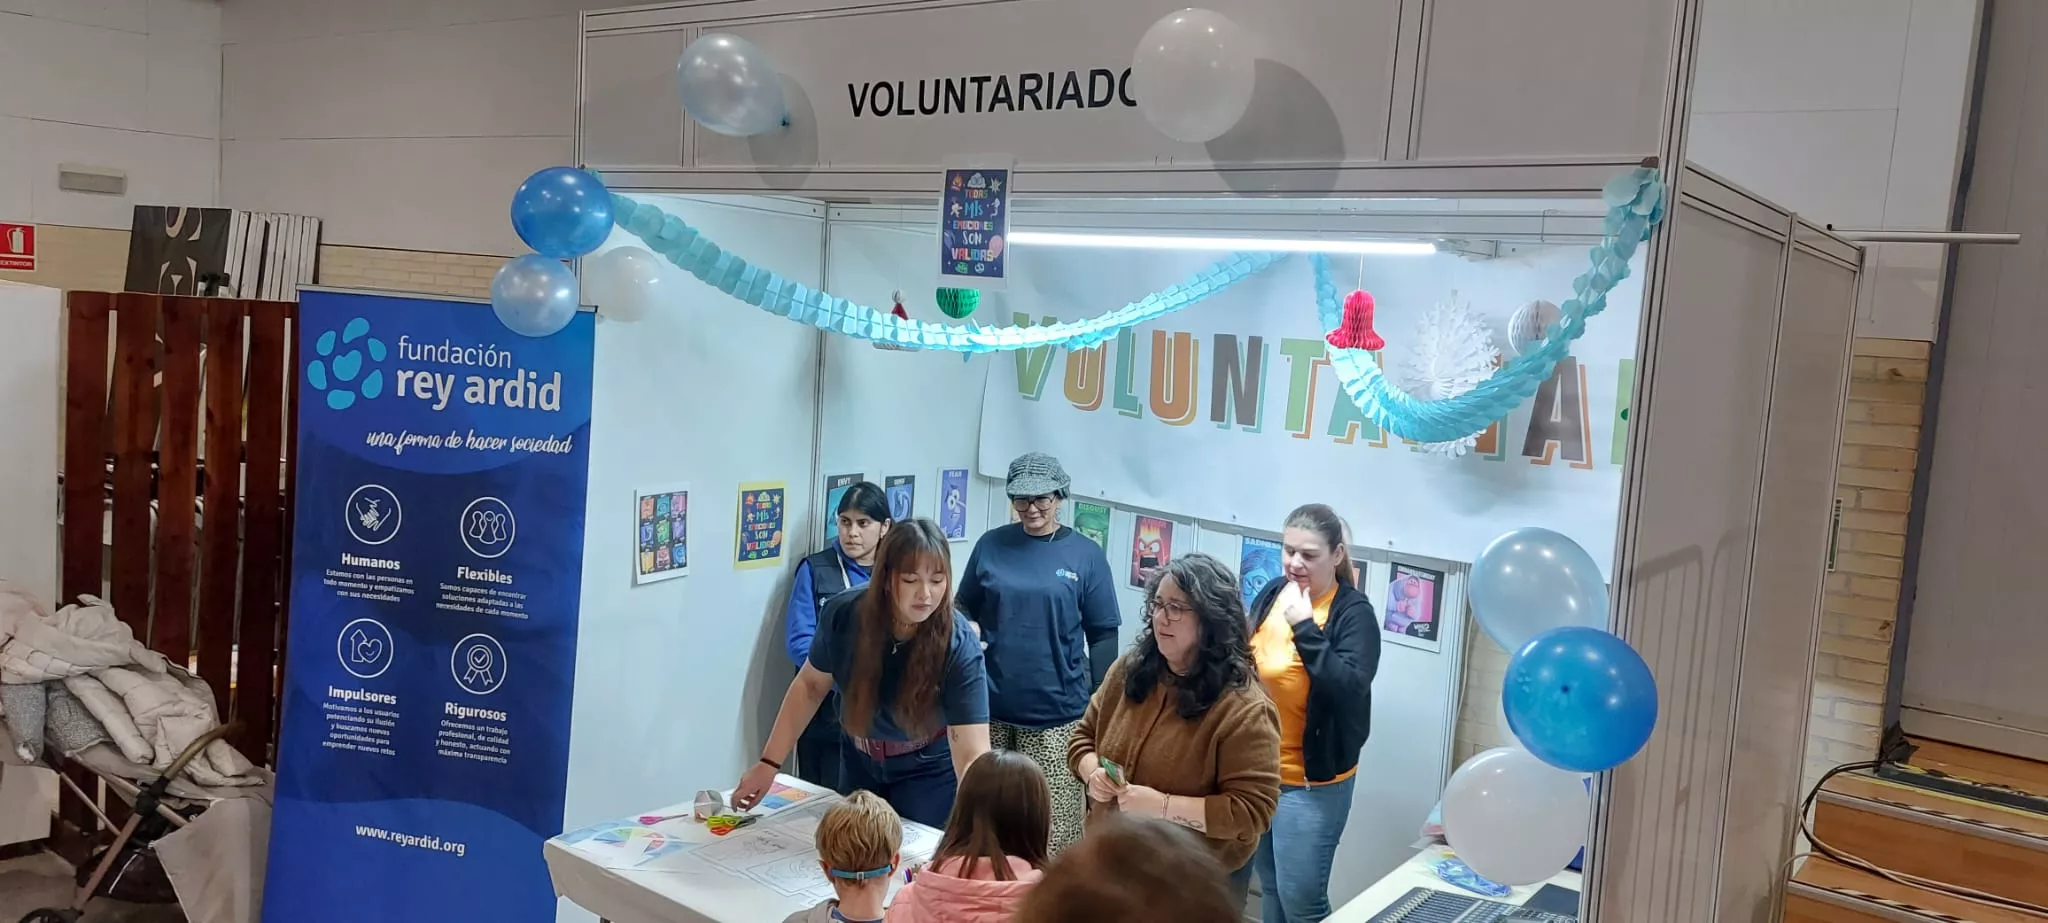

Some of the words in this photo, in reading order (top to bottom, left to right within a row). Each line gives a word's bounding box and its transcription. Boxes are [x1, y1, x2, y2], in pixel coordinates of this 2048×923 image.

[962, 231, 982, 245] SON
[398, 335, 511, 368] fundación
[396, 369, 455, 411] rey
[463, 368, 562, 411] ardid
[366, 431, 395, 447] una
[393, 430, 443, 455] forma
[444, 430, 463, 448] de
[465, 429, 507, 450] hacer
[509, 434, 573, 454] sociedad
[341, 552, 401, 570] Humanos
[457, 566, 513, 585] Flexibles
[328, 685, 397, 705] Impulsores
[445, 701, 508, 722] Rigurosos
[355, 825, 466, 857] www.reyardid.org
